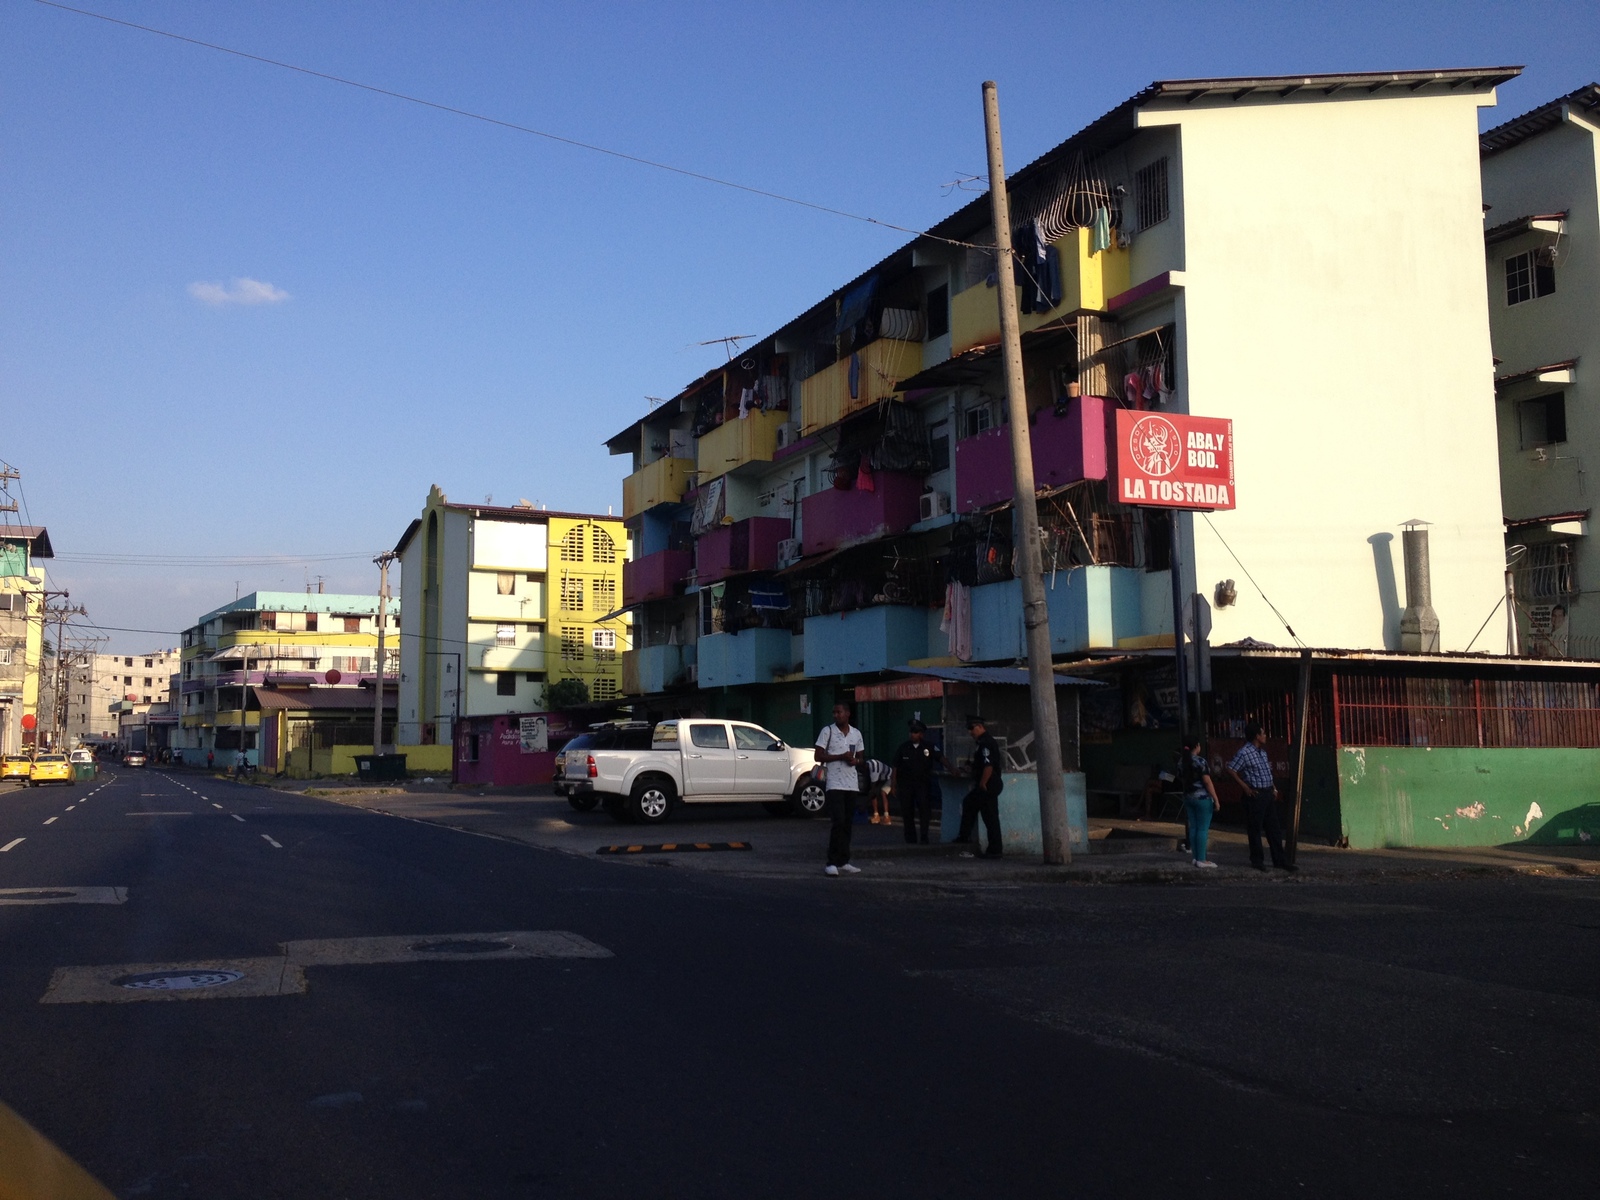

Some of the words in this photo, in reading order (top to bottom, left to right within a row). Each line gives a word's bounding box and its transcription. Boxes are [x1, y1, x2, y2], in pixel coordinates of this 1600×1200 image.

[1187, 450, 1219, 469] BOD.
[1124, 478, 1146, 499] LA
[1149, 480, 1230, 505] TOSTADA
